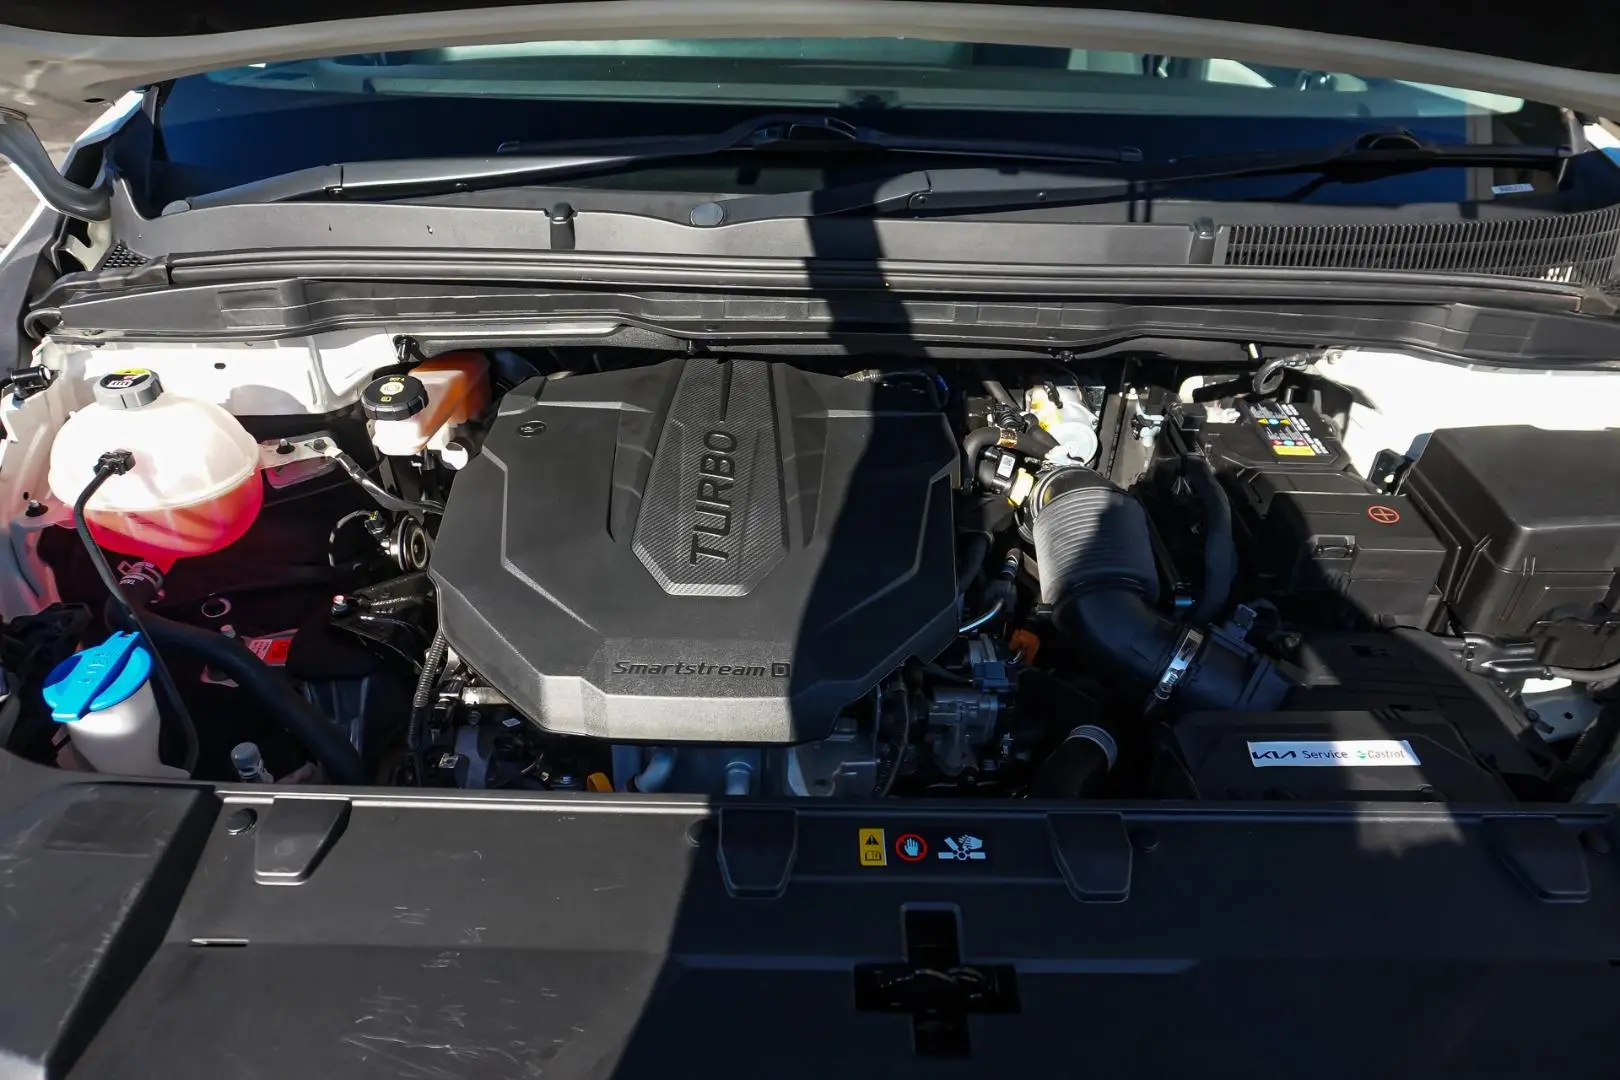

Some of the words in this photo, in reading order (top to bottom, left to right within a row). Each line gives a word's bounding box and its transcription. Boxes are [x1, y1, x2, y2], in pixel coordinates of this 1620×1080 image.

[690, 430, 737, 566] TURBO
[613, 660, 766, 677] Smartstream
[1302, 750, 1349, 759] Service
[1368, 749, 1405, 759] Castrol
